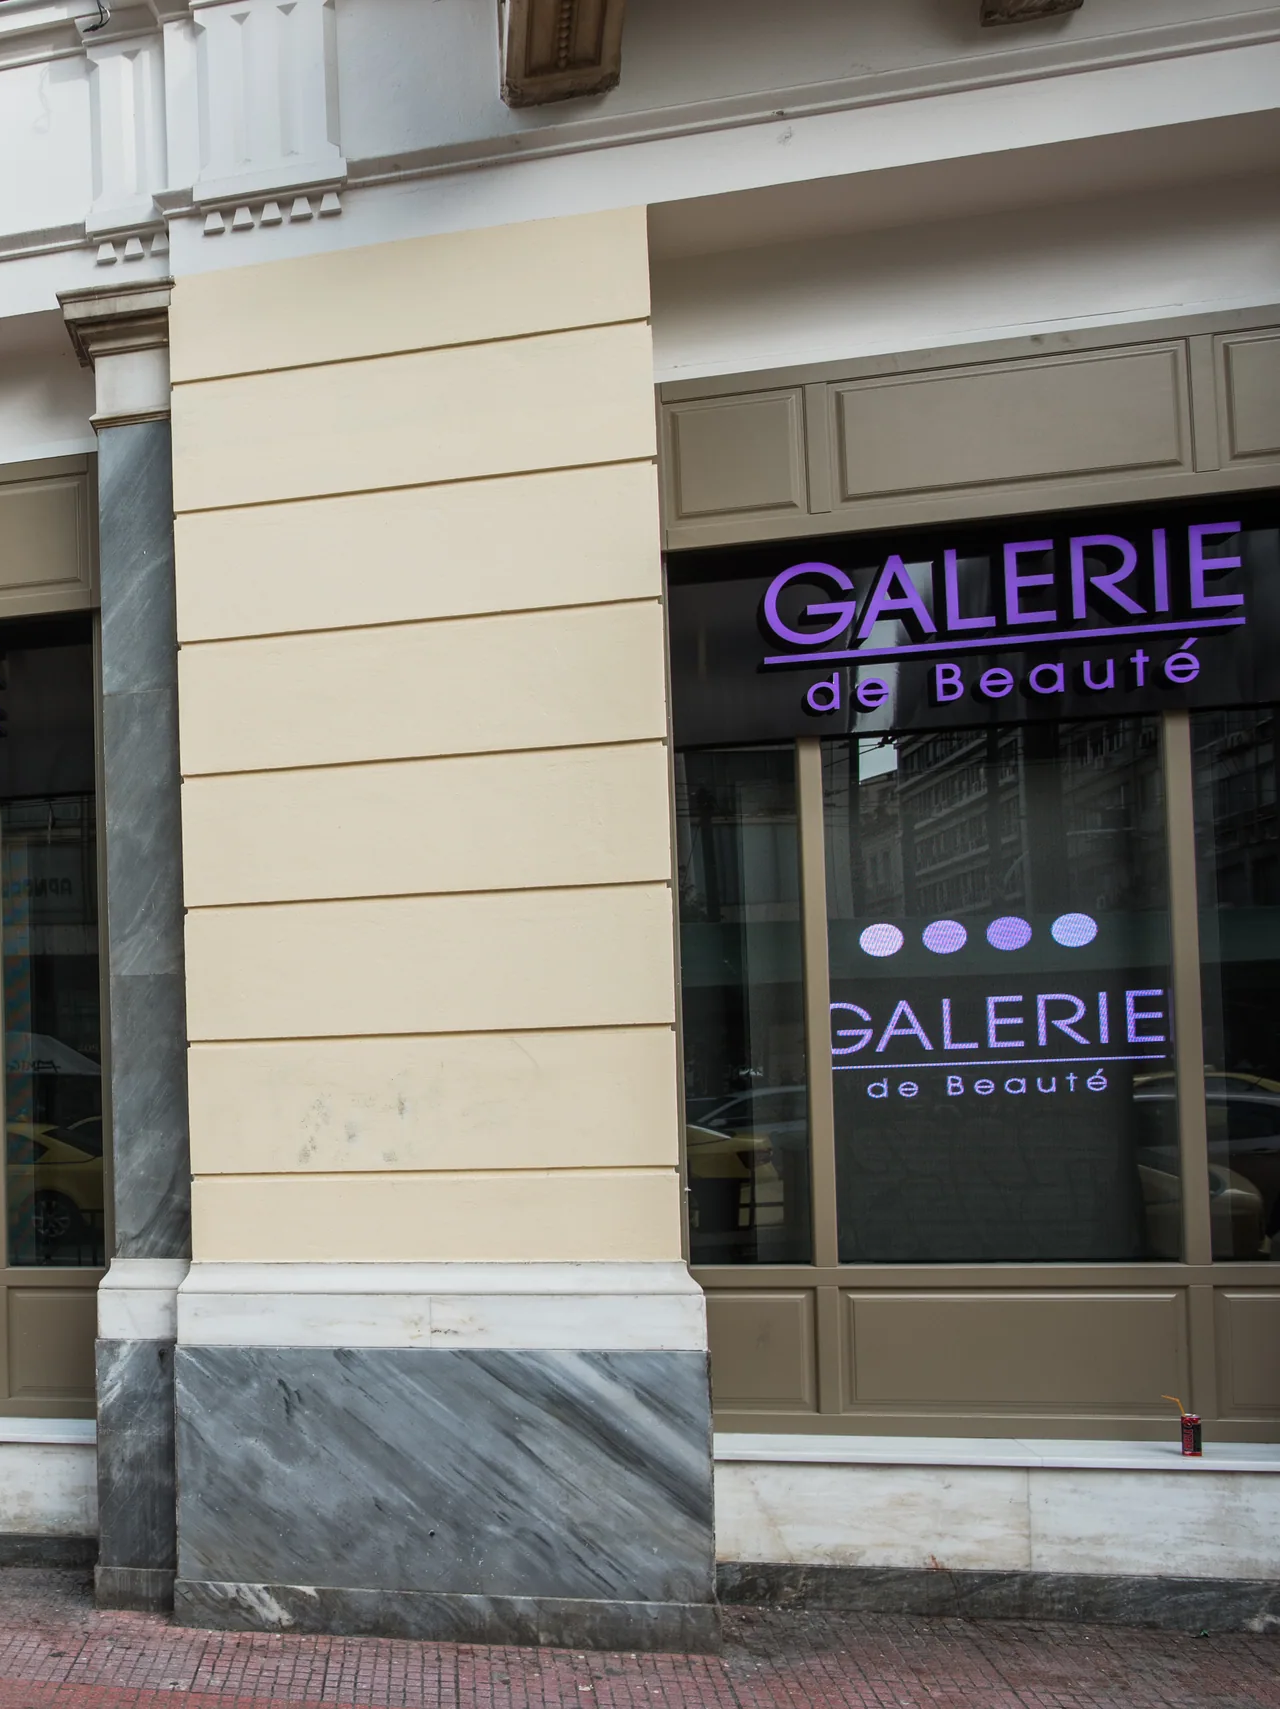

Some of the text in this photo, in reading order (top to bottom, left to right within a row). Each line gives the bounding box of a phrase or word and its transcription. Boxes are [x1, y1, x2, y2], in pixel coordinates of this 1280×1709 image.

[764, 521, 1246, 646] GALERIE
[807, 637, 1201, 711] de Beauté
[829, 988, 1166, 1055] GALERIE
[867, 1068, 1108, 1098] de Beauté
